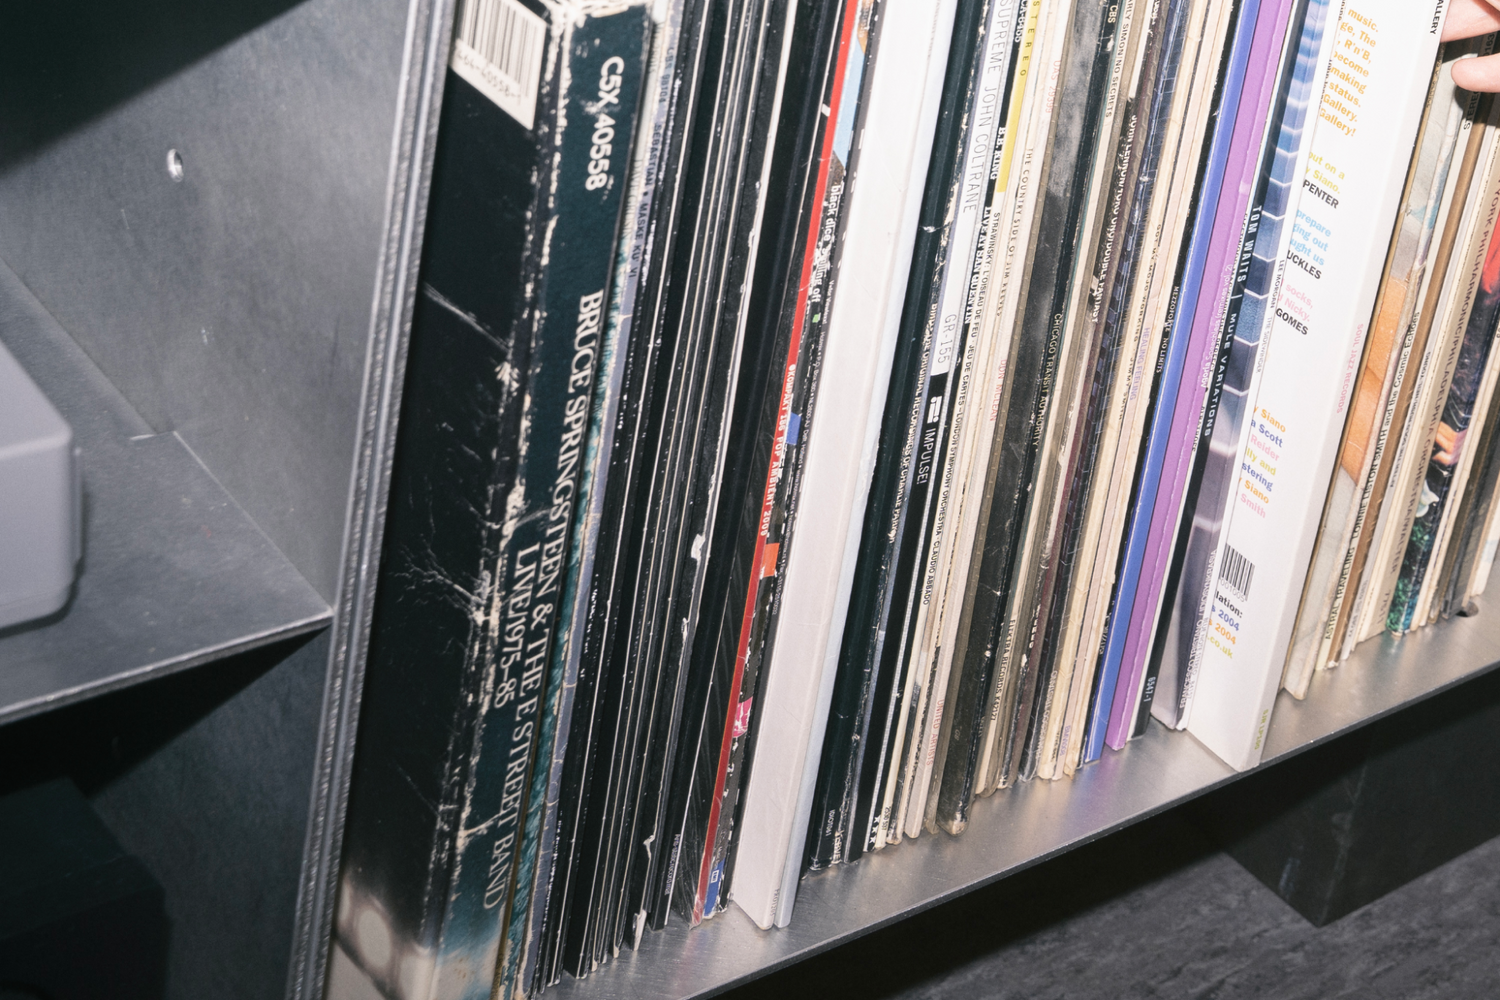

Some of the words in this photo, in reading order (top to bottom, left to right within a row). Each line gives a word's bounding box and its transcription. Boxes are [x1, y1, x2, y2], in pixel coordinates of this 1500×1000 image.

[1105, 5, 1119, 22] CBS
[1348, 8, 1379, 33] music.
[986, 0, 1013, 74] SUPREME
[1018, 0, 1040, 76] STEREO
[1359, 30, 1377, 48] The
[1049, 60, 1061, 79] UAS
[1330, 66, 1367, 95] making
[976, 87, 997, 127] JOHN
[1104, 77, 1119, 117] SECRETS
[1323, 94, 1358, 123] Gallery.
[1328, 82, 1361, 108] status.
[1319, 108, 1357, 137] Gallery!
[583, 115, 616, 189] 40558
[994, 127, 1006, 148] B.B.
[643, 124, 663, 185] SEBASTIAN
[988, 151, 1002, 179] KING
[1023, 147, 1034, 164] THE
[961, 134, 990, 213] COLTRANE
[1312, 169, 1341, 195] Siano.
[1324, 162, 1337, 174] on
[1338, 170, 1346, 180] a
[825, 184, 842, 216] black
[1014, 169, 1030, 214] COUNTRY
[1302, 179, 1339, 209] PENTER
[634, 203, 649, 239] MASKE
[979, 206, 991, 234] LIVE
[1246, 205, 1262, 232] TOM
[1296, 209, 1331, 238] prepare
[1483, 192, 1500, 229] YORK
[820, 218, 836, 240] dice
[977, 234, 986, 248] AT
[983, 212, 1000, 268] STRAWINSKY:
[1009, 218, 1020, 240] SIDE
[1312, 235, 1330, 252] out
[972, 250, 983, 272] SAN
[1236, 239, 1254, 282] WAITS
[1277, 259, 1285, 271] LEE
[1286, 250, 1322, 280] UCKLES
[1312, 253, 1325, 267] us
[976, 271, 990, 306] L'OISEAU
[1143, 264, 1153, 291] MOJO
[1269, 274, 1282, 308] MORGAN
[809, 288, 822, 302] off
[963, 274, 979, 324] QUENTIN
[1284, 295, 1311, 322] Nicky.
[1285, 283, 1314, 310] socks,
[973, 309, 982, 319] DE
[1132, 295, 1147, 342] WORKING
[1264, 317, 1273, 329] THE
[1275, 307, 1309, 336] GOMES
[567, 290, 604, 392] BRUCE
[935, 314, 958, 363] GR-155
[969, 321, 979, 337] FEU
[1047, 313, 1062, 353] CHICAGO
[1159, 337, 1169, 348] NO
[1222, 312, 1237, 348] MULE
[1351, 323, 1364, 346] SOUL
[1403, 312, 1421, 347] Echoes
[965, 345, 975, 359] JEU
[1136, 327, 1150, 363] HEALING
[1345, 349, 1358, 370] JAZZ
[914, 351, 929, 395] ORIGINAL
[963, 362, 972, 372] DE
[996, 359, 1007, 378] DON
[1040, 356, 1055, 392] TRANSIT
[1124, 357, 1134, 386] JIMMY
[1154, 350, 1166, 372] LIMITS
[1391, 352, 1410, 387] Cosmic
[957, 374, 969, 405] CARTES
[1129, 366, 1142, 400] FEELING
[1203, 355, 1227, 436] VARIATIONS
[1335, 373, 1352, 413] RECORDS
[1387, 390, 1398, 405] the
[1117, 391, 1128, 420] SMITH
[1382, 408, 1394, 425] and
[777, 414, 787, 431] 186
[950, 413, 964, 445] LONDON
[1031, 396, 1048, 445] AUTHORITY
[1260, 408, 1287, 433] Siano
[772, 437, 783, 456] POP
[1250, 434, 1280, 462] Reider
[1258, 423, 1283, 449] Scott
[1372, 429, 1388, 458] SMITH
[914, 428, 937, 484] IMPULSE!
[942, 447, 957, 488] SYMPHONY
[1260, 457, 1277, 476] and
[764, 461, 779, 506] AMBIENT
[1241, 461, 1274, 493] stering
[1361, 465, 1379, 497] LISTON
[534, 396, 587, 598] SPRINGSTEEN
[1240, 493, 1266, 519] Smith
[1244, 480, 1270, 505] Siano
[759, 510, 771, 536] 2009
[934, 491, 949, 535] ORCHESTRA
[1350, 501, 1368, 539] LONNIE
[927, 540, 940, 573] CLAUDIO
[1334, 547, 1356, 599] TRAVELING
[921, 575, 934, 604] ABBADO
[530, 603, 552, 628] &
[1214, 590, 1244, 619] lation:
[1214, 622, 1237, 646] 2004
[1218, 608, 1240, 632] 2004
[1324, 601, 1341, 639] ASTRAL
[1003, 619, 1016, 653] ELEKTRA
[518, 628, 550, 696] THE
[995, 656, 1009, 693] RECORDS
[1178, 658, 1196, 708] FRANCESCO
[1189, 620, 1204, 656] TRISTANO
[1143, 676, 1156, 701] 6547-1
[514, 695, 538, 721] E
[931, 699, 945, 728] UNITED
[924, 734, 938, 765] ARTISTS
[495, 721, 534, 825] STREET
[481, 830, 515, 909] BAND
